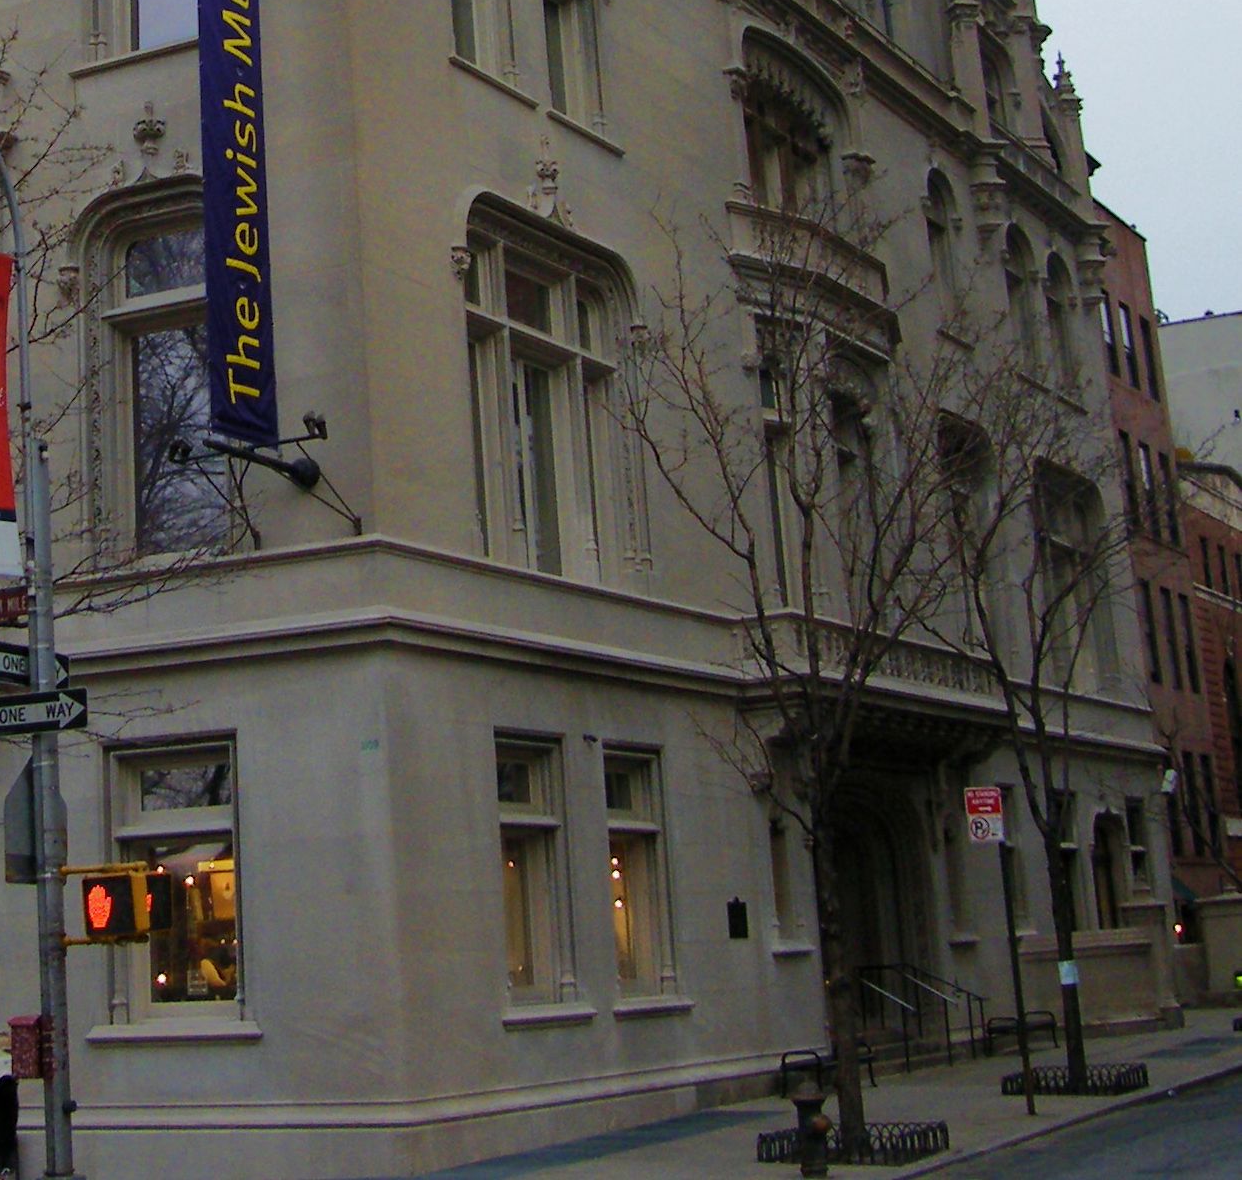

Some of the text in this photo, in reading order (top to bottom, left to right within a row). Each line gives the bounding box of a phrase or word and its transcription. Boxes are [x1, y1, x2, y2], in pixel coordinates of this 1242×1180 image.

[223, 81, 262, 284] Jewish
[225, 295, 261, 405] The
[7, 595, 27, 613] MILE
[2, 654, 26, 671] ONE
[45, 702, 75, 719] WAY
